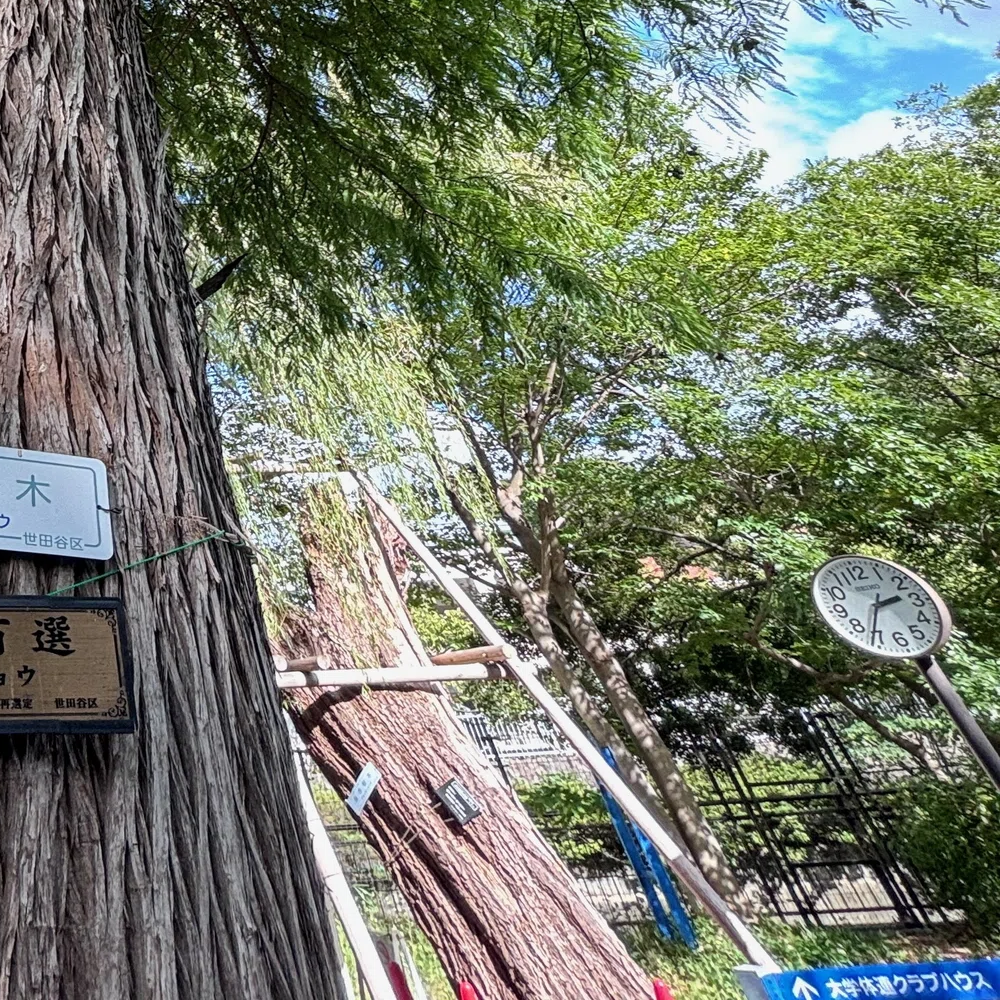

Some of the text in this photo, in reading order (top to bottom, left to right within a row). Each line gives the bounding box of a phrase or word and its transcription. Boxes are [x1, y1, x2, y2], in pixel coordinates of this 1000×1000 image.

[22, 531, 84, 551] 世田谷区
[833, 571, 851, 587] 11
[846, 565, 869, 581] 12
[872, 566, 884, 581] 1
[891, 575, 908, 591] 2
[826, 585, 846, 601] 10
[907, 592, 926, 608] 3
[832, 603, 849, 619] 9
[917, 610, 931, 625] 4
[849, 618, 866, 634] 8
[907, 624, 926, 640] 5
[892, 631, 909, 648] 6
[54, 698, 98, 710] 世田谷区
